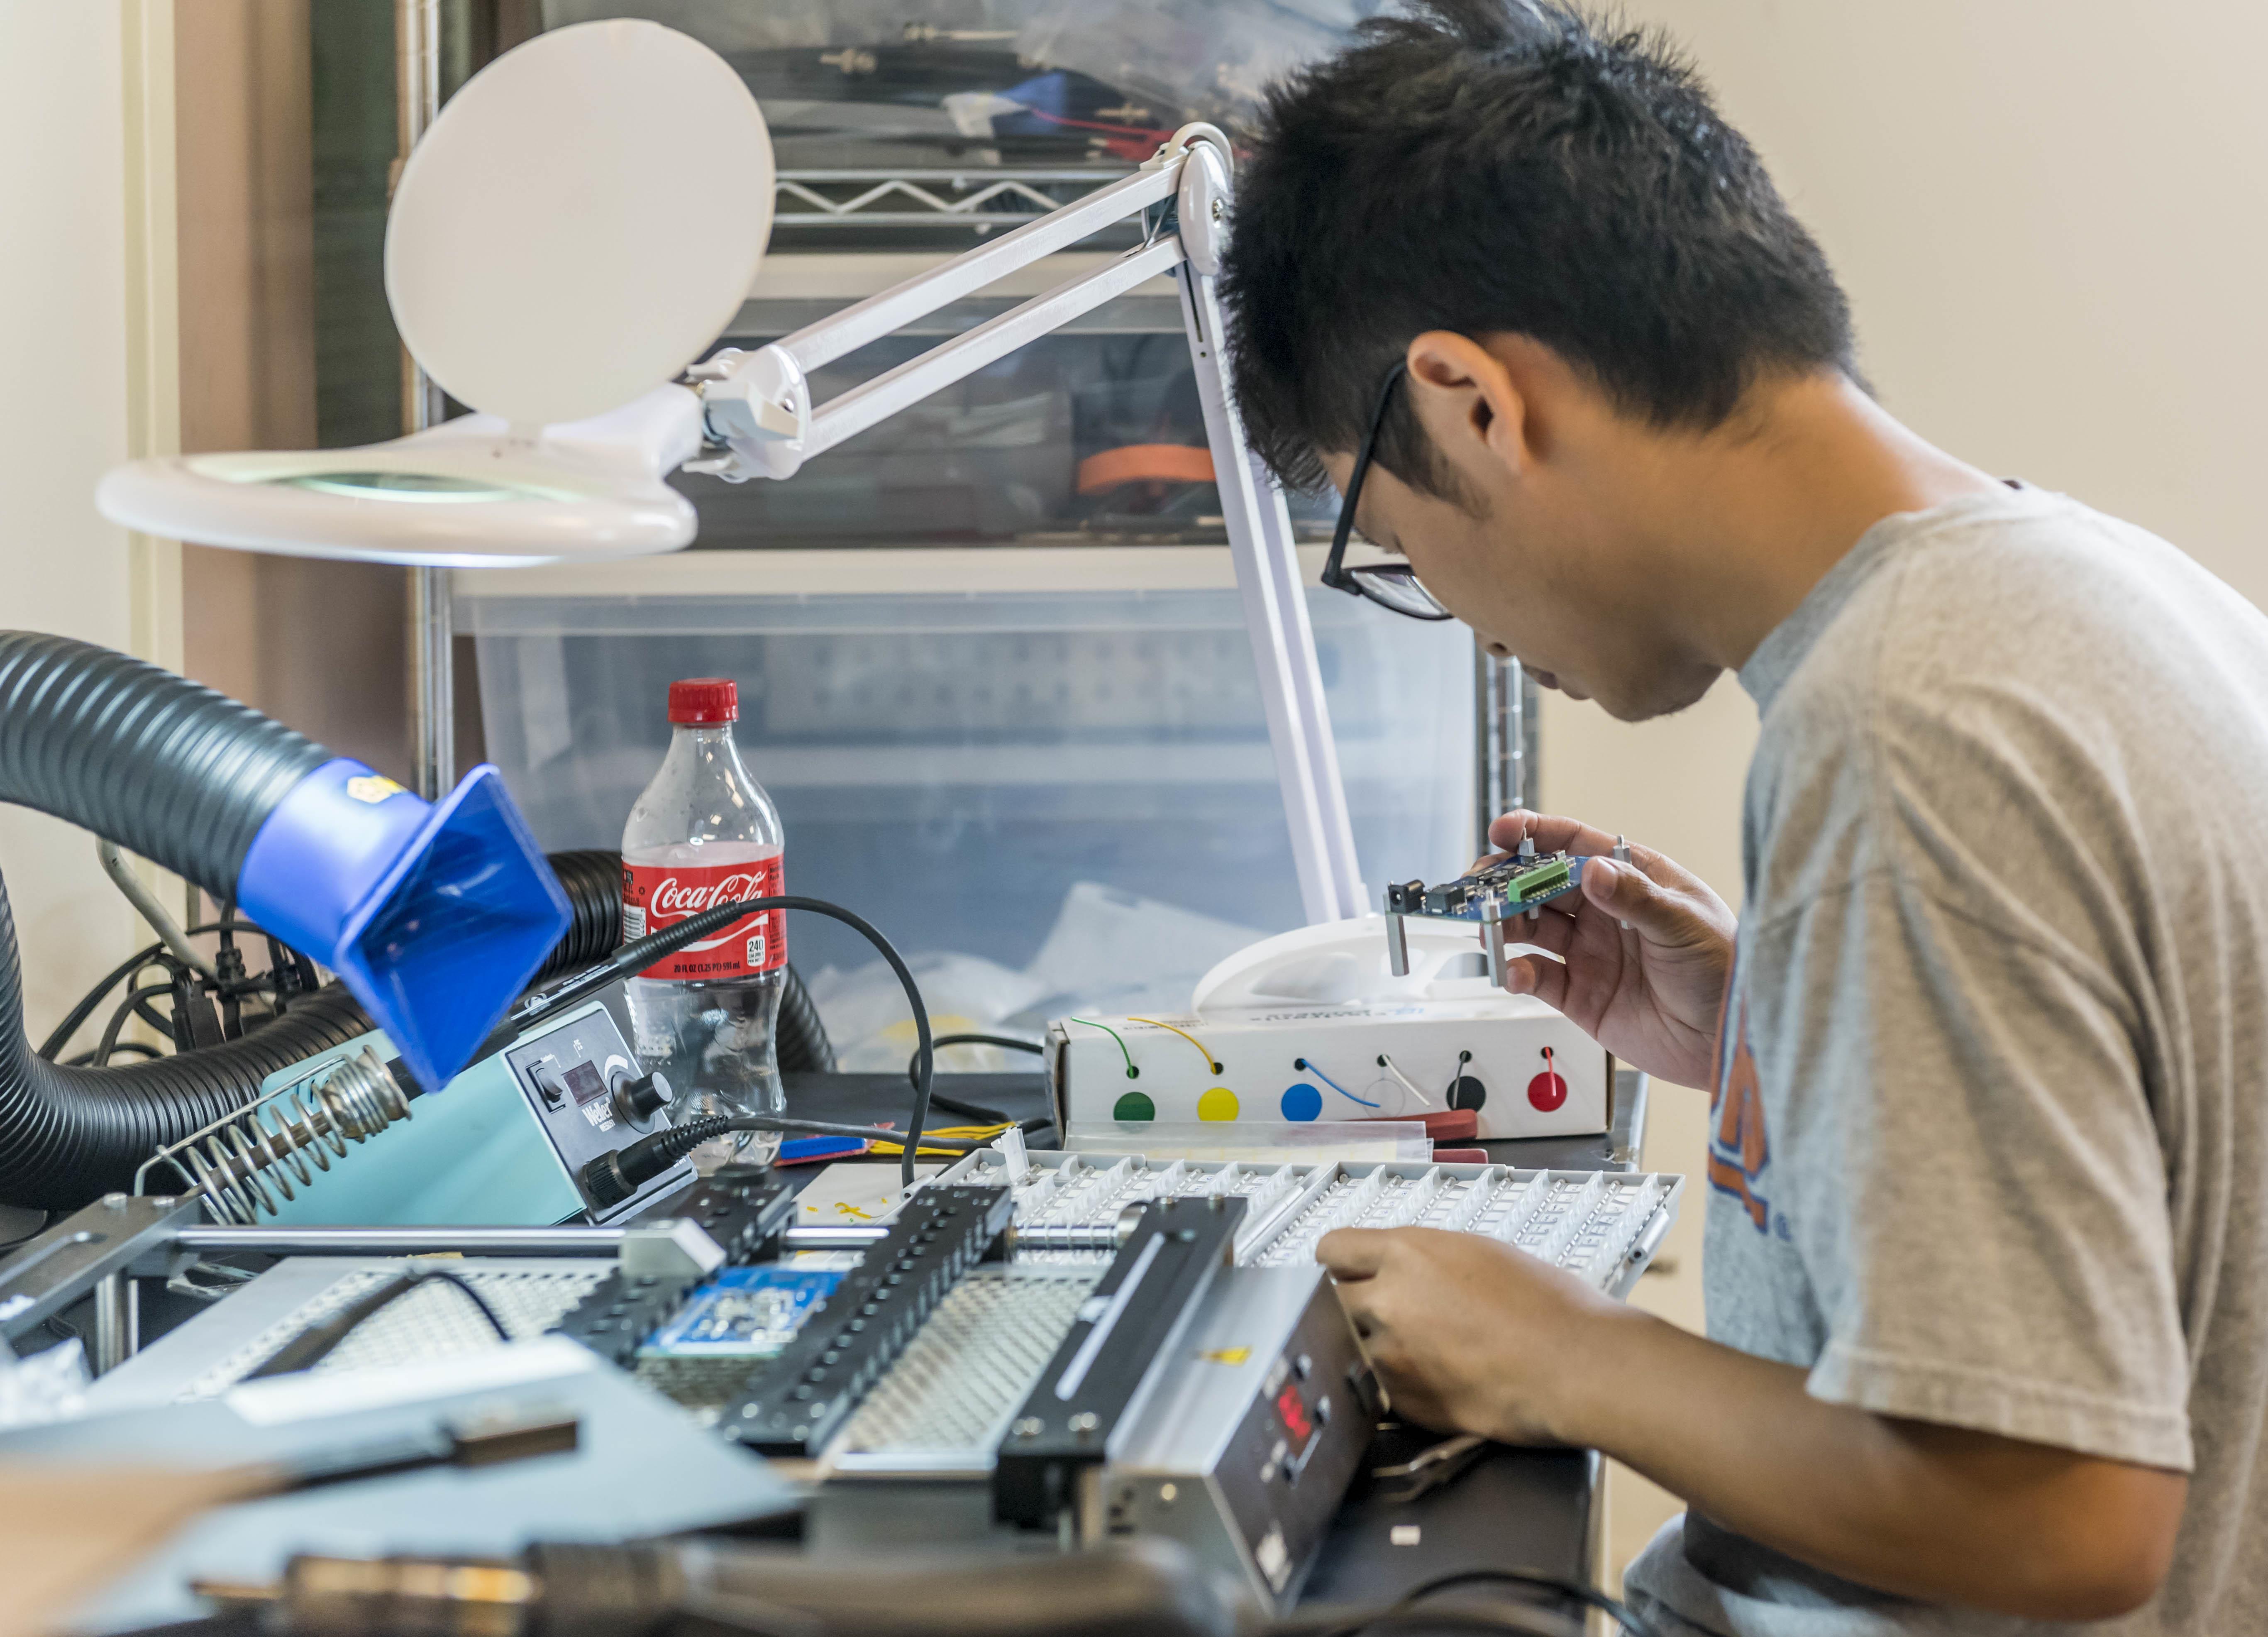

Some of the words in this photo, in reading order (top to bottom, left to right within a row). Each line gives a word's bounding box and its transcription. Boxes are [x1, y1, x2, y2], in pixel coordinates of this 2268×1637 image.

[651, 870, 767, 918] Coca-Cola
[749, 939, 763, 952] 240
[674, 964, 681, 972] 20
[682, 964, 688, 972] FL
[689, 964, 696, 972] OZ
[698, 963, 711, 972] (1.25
[712, 963, 722, 972] PT)
[723, 962, 732, 970] 591
[581, 1102, 613, 1126] Weller
